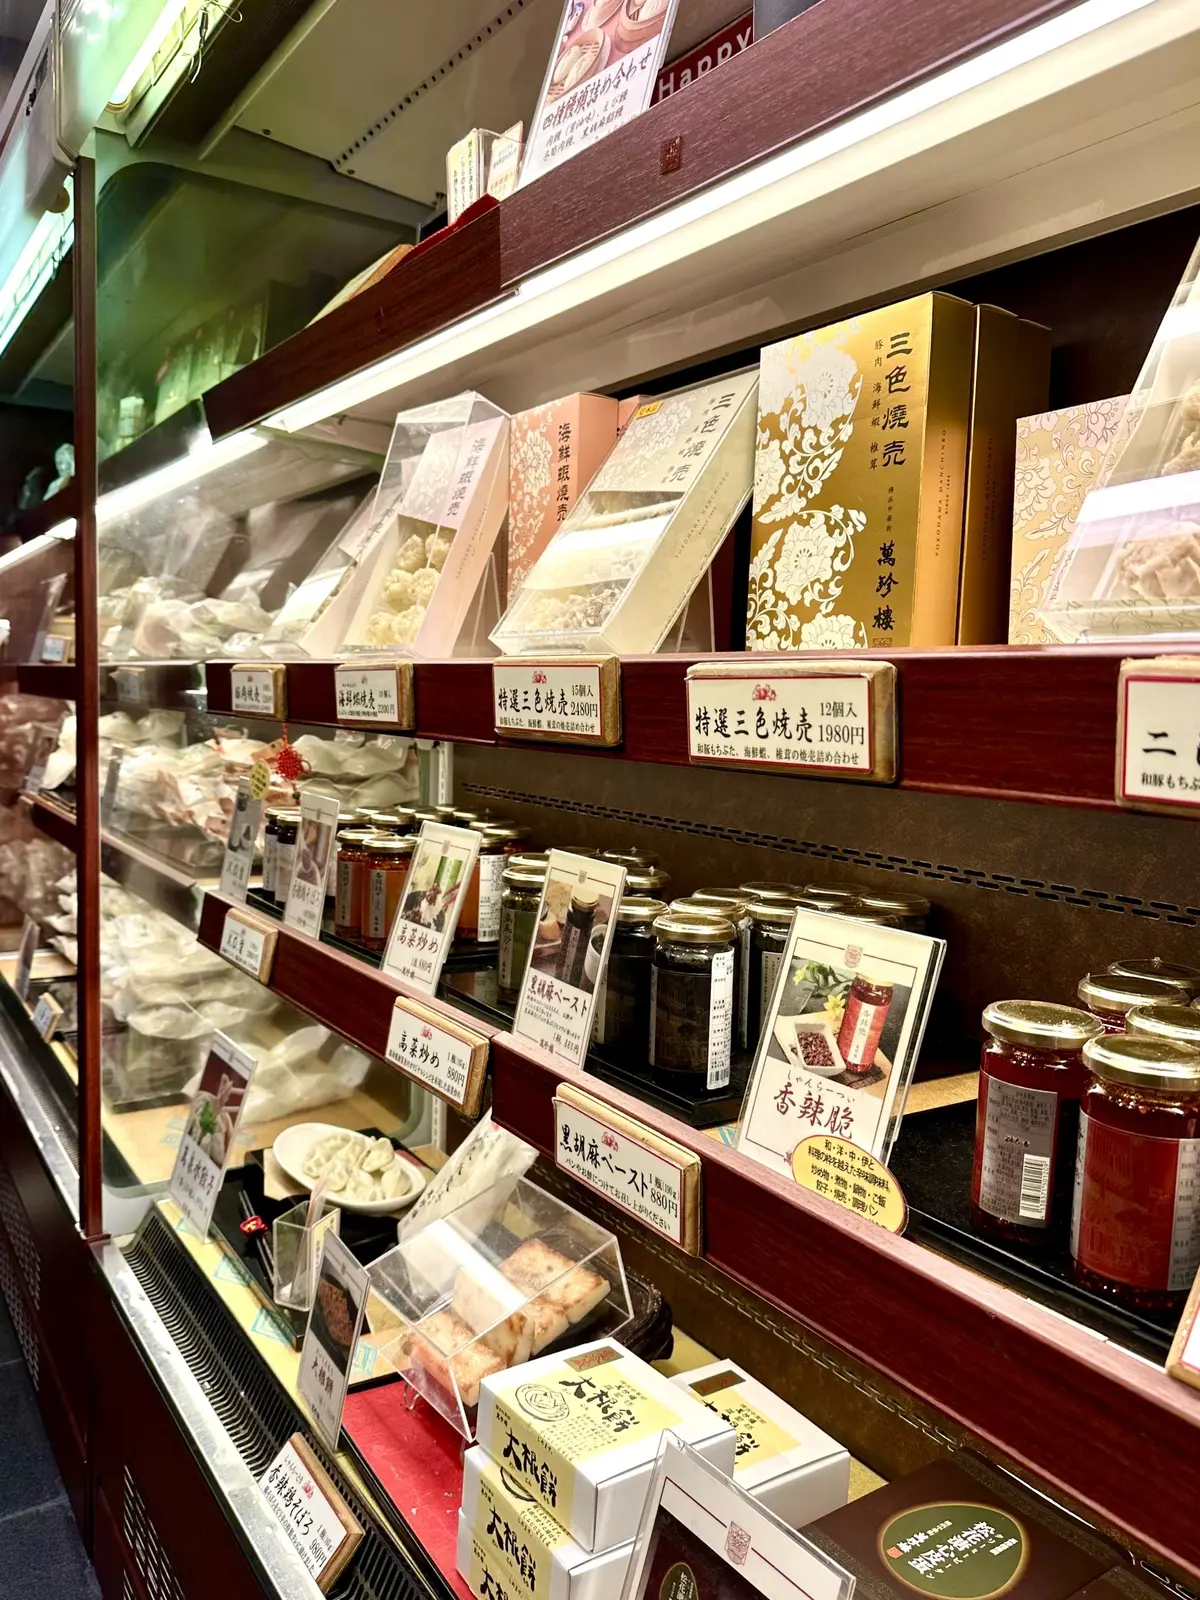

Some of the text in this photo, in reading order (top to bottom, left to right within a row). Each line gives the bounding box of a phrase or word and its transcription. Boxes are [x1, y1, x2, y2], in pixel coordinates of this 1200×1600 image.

[659, 26, 752, 100] Happy
[675, 519, 701, 559] YOKOHAMA
[935, 499, 943, 557] YOKOHAMA
[872, 540, 898, 630] 萬珍樓
[498, 688, 568, 717] 特選三色焼売
[570, 701, 598, 717] 2480円
[571, 685, 594, 697] 15個入
[820, 701, 858, 718] 12個入
[695, 706, 813, 743] 特選三色焼売
[818, 724, 865, 745] 1980円
[397, 923, 439, 954] 高菜炒め
[528, 975, 587, 1017] 黒胡麻ペースト
[398, 1031, 440, 1068] 高菜炒め
[446, 1066, 465, 1087] 880円
[773, 1082, 855, 1140] 香辣脆
[560, 1124, 648, 1198] 黒胡麻ペースト
[650, 1188, 678, 1218] 880円
[559, 1375, 640, 1433] 大根餅
[503, 1427, 557, 1508] 大根餅
[268, 1464, 314, 1536] 香辣鶏そぼろ
[309, 1538, 327, 1568] 980円
[486, 1505, 537, 1592] 大根餅
